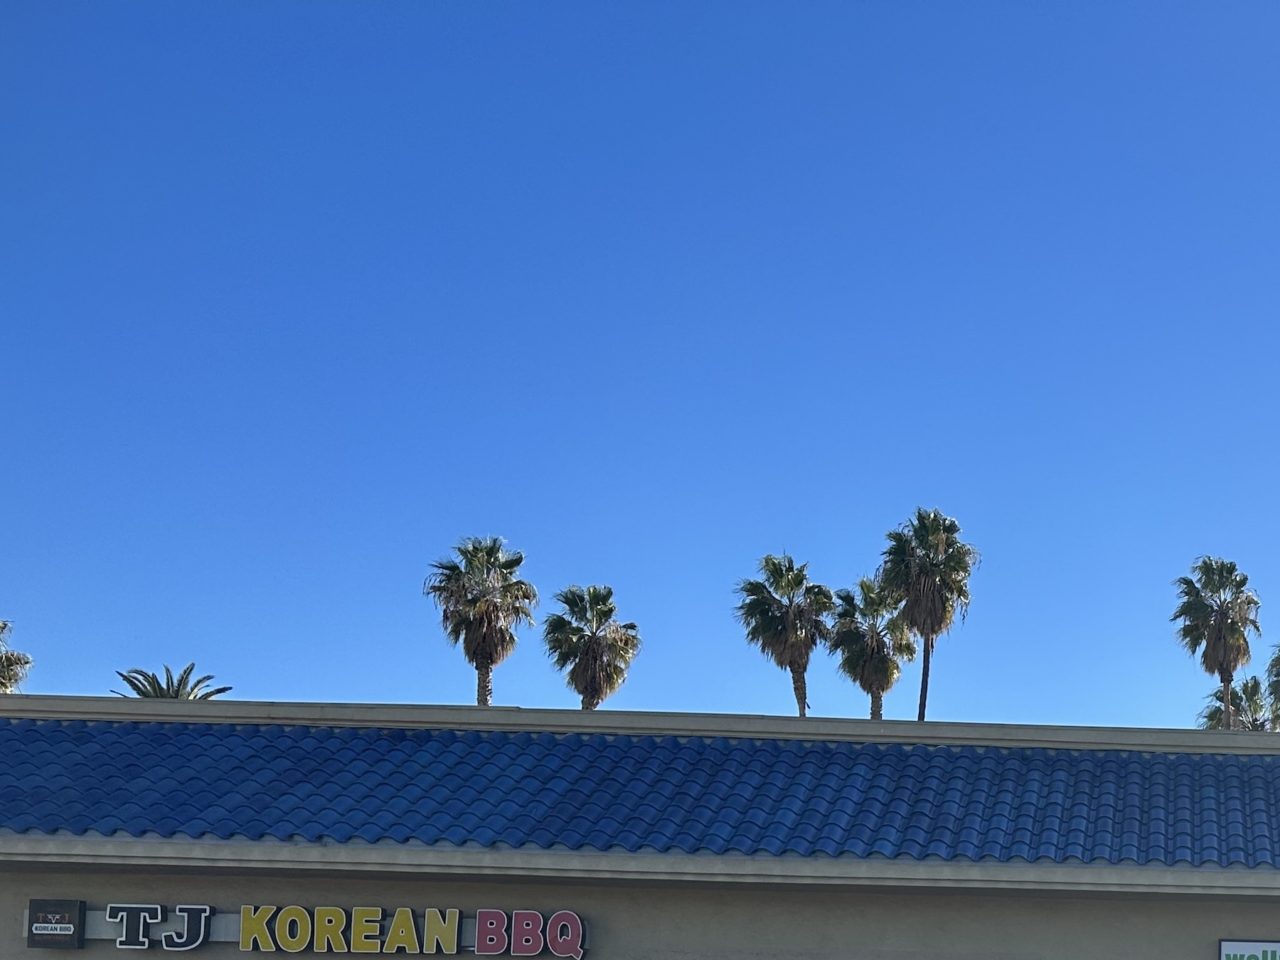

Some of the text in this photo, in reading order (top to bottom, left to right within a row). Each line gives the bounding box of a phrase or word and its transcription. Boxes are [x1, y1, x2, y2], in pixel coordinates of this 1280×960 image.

[106, 903, 586, 960] TJ KOREAN BBQ
